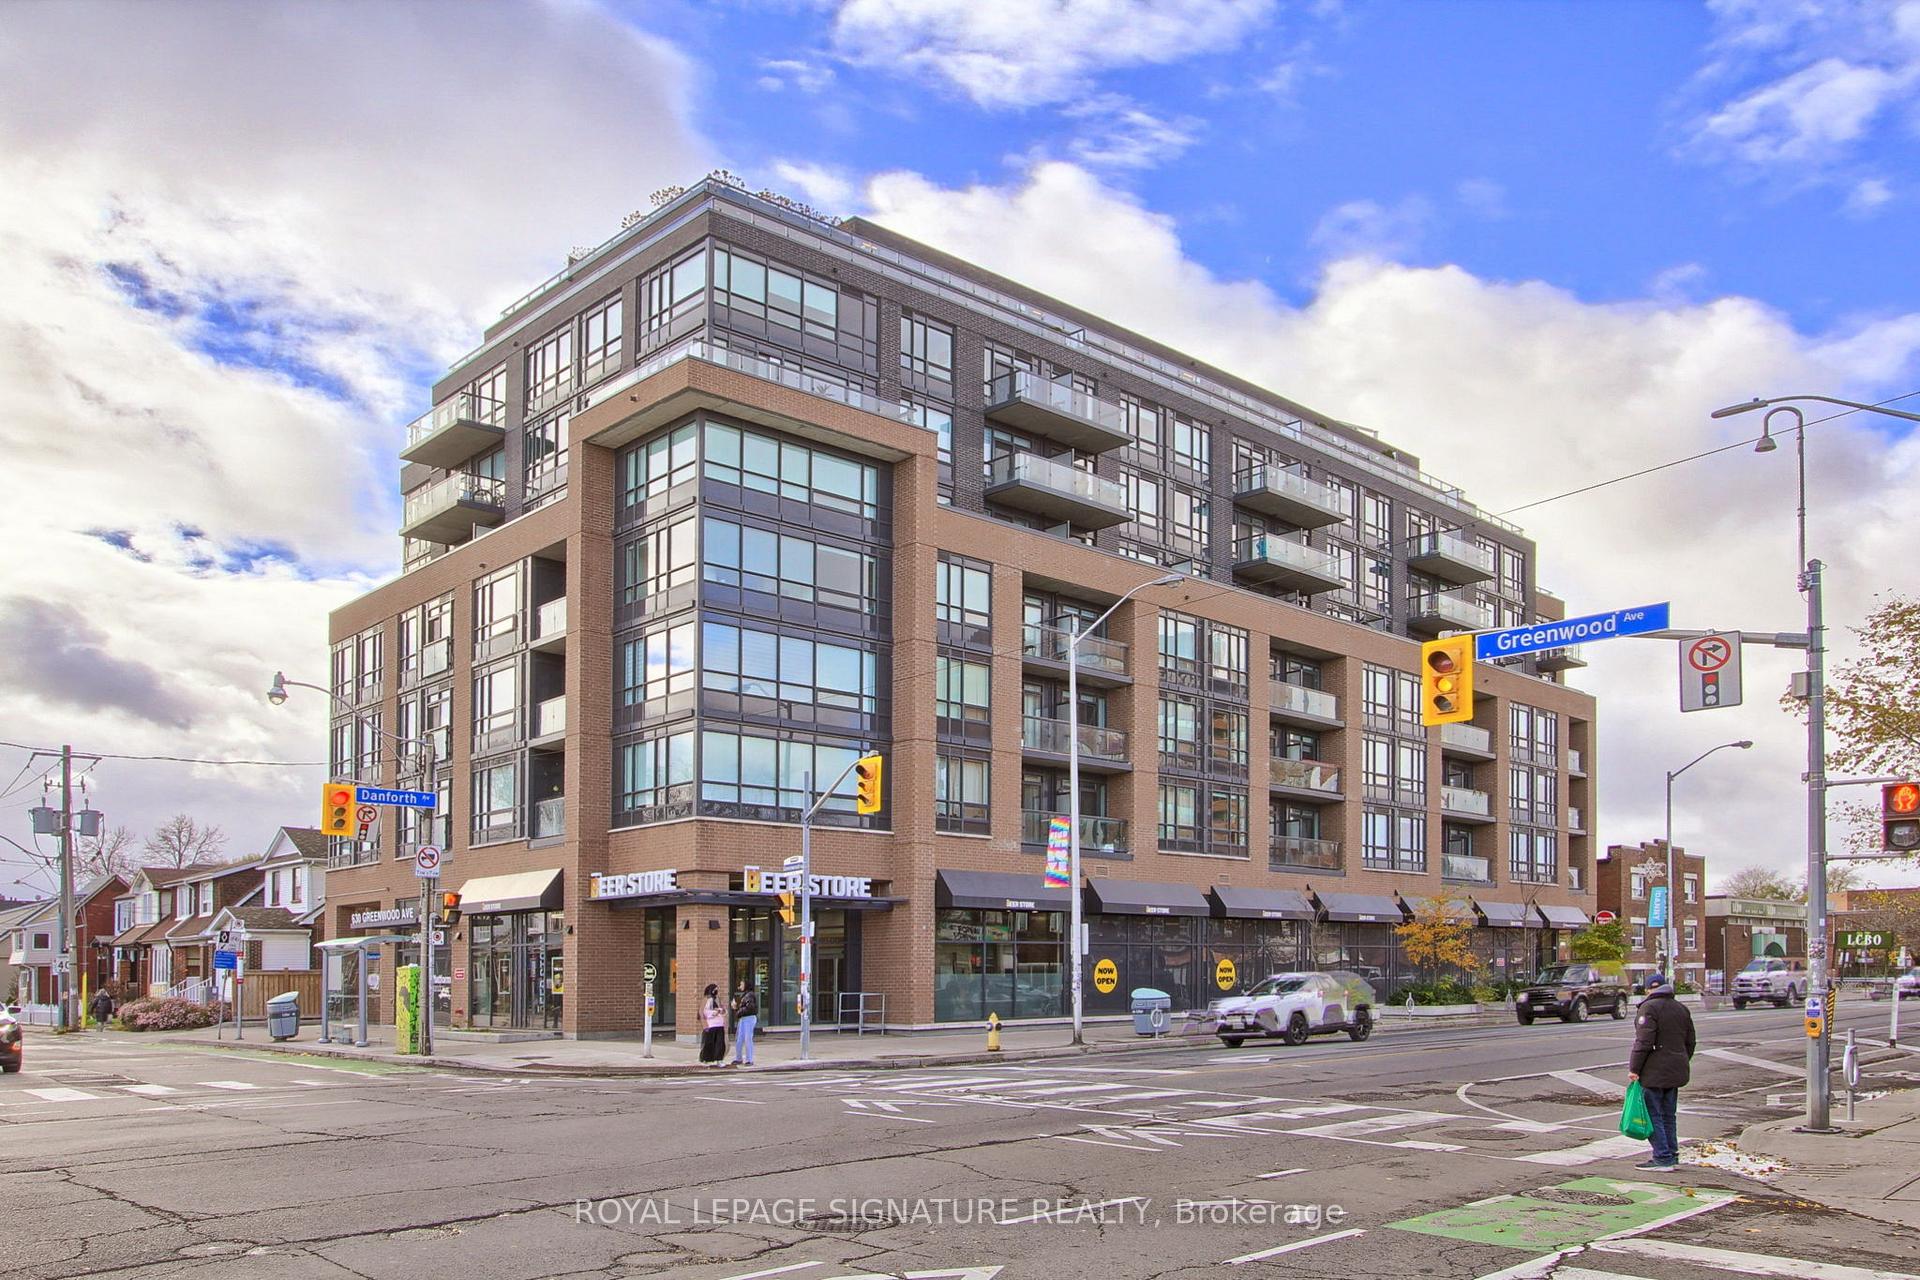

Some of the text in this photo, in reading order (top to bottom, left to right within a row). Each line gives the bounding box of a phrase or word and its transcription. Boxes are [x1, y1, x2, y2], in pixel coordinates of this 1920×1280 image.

[1497, 611, 1645, 650] Greenwood Ave
[361, 789, 417, 804] Danforth
[590, 868, 677, 898] BEER STORE
[744, 865, 872, 898] BEER STORE
[362, 908, 401, 923] GREENWOOD
[401, 907, 414, 920] AVE
[1847, 933, 1882, 946] LCBO
[1097, 967, 1115, 975] NOW
[1096, 977, 1115, 985] OPEN
